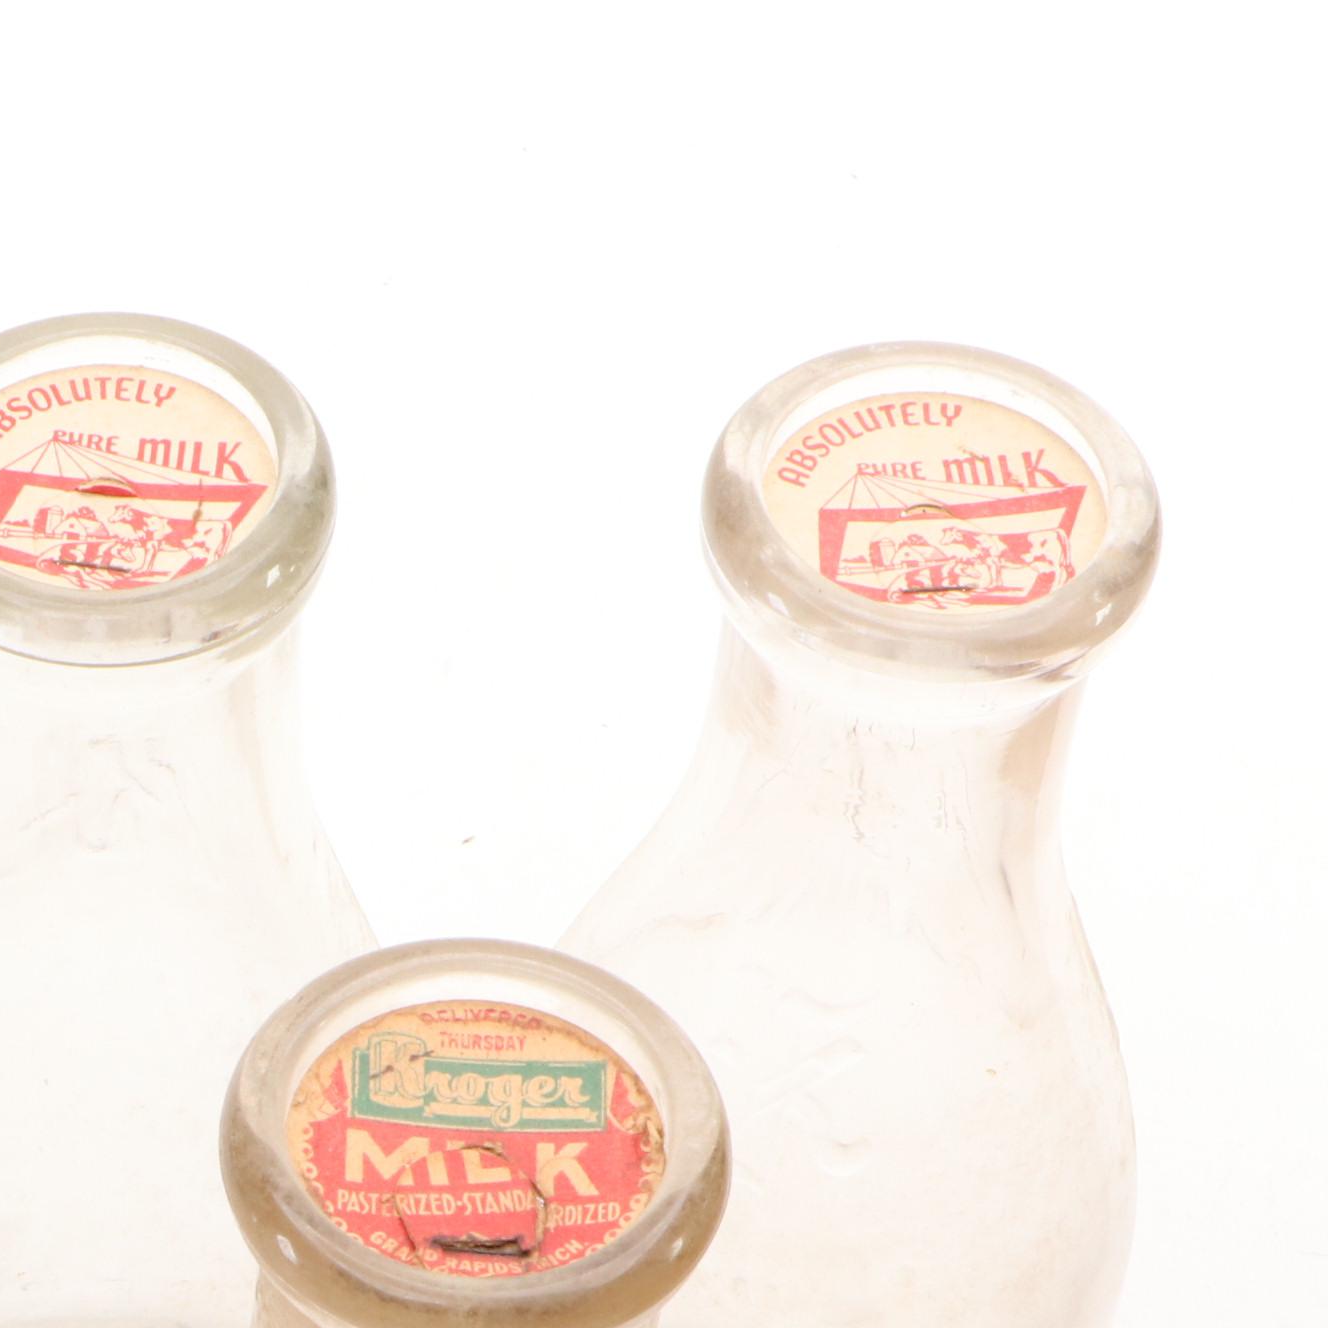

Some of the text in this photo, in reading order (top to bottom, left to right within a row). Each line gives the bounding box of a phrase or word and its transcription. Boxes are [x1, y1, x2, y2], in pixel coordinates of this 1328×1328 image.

[52, 430, 253, 484] PURE MILK
[777, 401, 963, 489] ABSOLUTELY
[857, 449, 1073, 489] PURE MILK
[419, 1008, 544, 1030] DELIVERED
[439, 1031, 527, 1051] THURSDAY
[370, 1037, 592, 1128] Kroger
[344, 1128, 600, 1197] MILK
